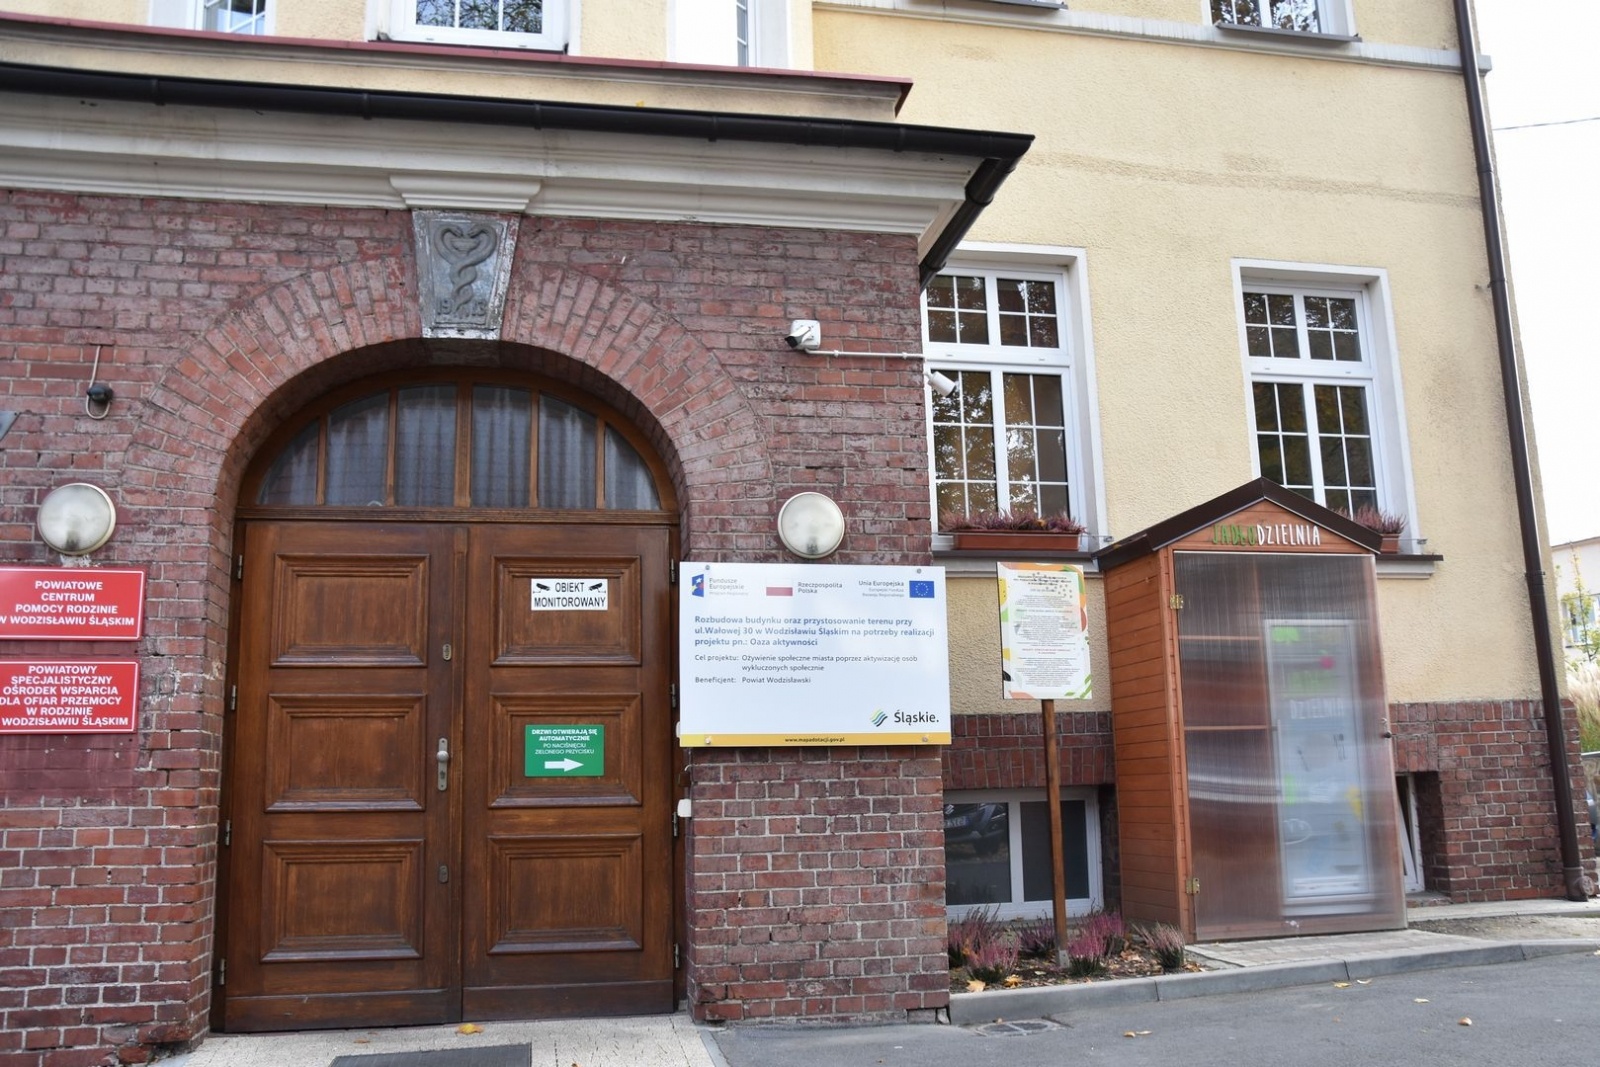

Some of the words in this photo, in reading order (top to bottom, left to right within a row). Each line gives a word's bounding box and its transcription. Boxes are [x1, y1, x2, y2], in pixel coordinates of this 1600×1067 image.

[35, 581, 103, 590] POWIATOWE
[555, 582, 584, 592] OBIEKT
[798, 582, 842, 590] Rzeczpospolita
[41, 593, 95, 602] CENTRUM
[534, 597, 606, 607] MONITOROWANY
[16, 604, 64, 613] POMOCY
[66, 605, 118, 614] RODZINIE
[10, 616, 86, 625] WODZISŁAWIU
[88, 614, 134, 627] ŚLĄSKIM
[694, 616, 743, 624] Rozbudowa
[746, 616, 782, 626] budynku
[804, 617, 866, 627] przystosowanie
[896, 619, 912, 627] przy
[765, 627, 816, 635] Wodzisławiu
[818, 626, 850, 637] Śląskim
[863, 629, 898, 638] potrzeby
[900, 628, 934, 638] realizacji
[694, 638, 730, 647] projektu
[772, 638, 818, 647] aktywności
[28, 666, 98, 674] POWIATOWY
[11, 676, 112, 684] SPECJALISTYCZNY
[3, 684, 57, 695] OŚRODEK
[60, 686, 118, 695] WSPARCIA
[0, 696, 20, 705] DLA
[24, 696, 58, 705] OFIAR
[60, 696, 122, 705] PRZEMOCY
[26, 707, 38, 716] W
[40, 707, 93, 716] RODZINIE
[2, 717, 79, 726] WODZISŁAWIU
[82, 715, 128, 728] ŚLĄSKIM
[894, 710, 940, 726] Śląskie.
